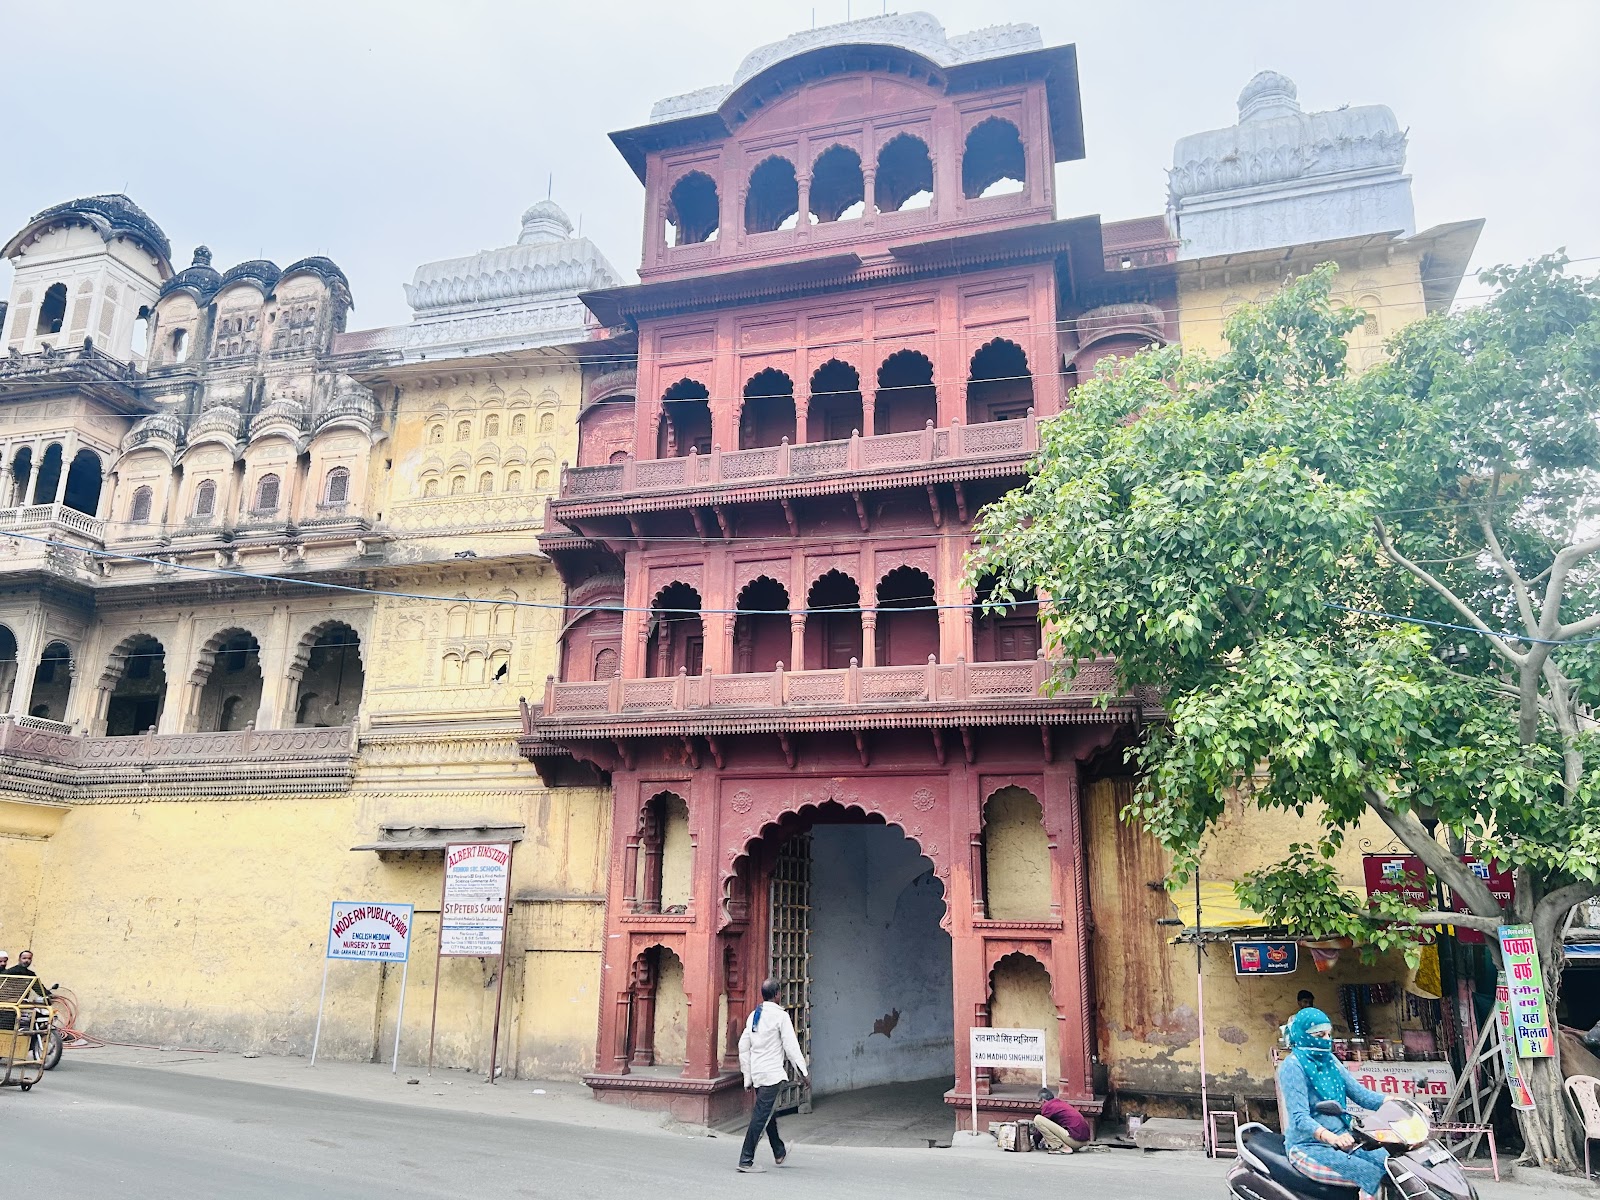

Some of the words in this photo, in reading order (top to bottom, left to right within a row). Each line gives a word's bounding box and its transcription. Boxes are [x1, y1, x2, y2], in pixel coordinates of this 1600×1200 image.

[448, 846, 477, 868] ALBERT
[477, 846, 508, 866] EINSTEIN
[480, 903, 503, 914] SCHOOL
[333, 907, 366, 938] MODERN
[367, 906, 391, 922] PUBLIC
[389, 914, 408, 939] SCHOOL
[343, 941, 369, 949] NURSERY
[1503, 938, 1535, 956] पक्का
[1513, 958, 1532, 980] बर्फ
[1513, 986, 1540, 995] रंगीन
[1522, 1010, 1540, 1023] यहां
[975, 1034, 986, 1042] राव
[1519, 1027, 1548, 1039] मिलता
[1380, 1075, 1399, 1093] टी
